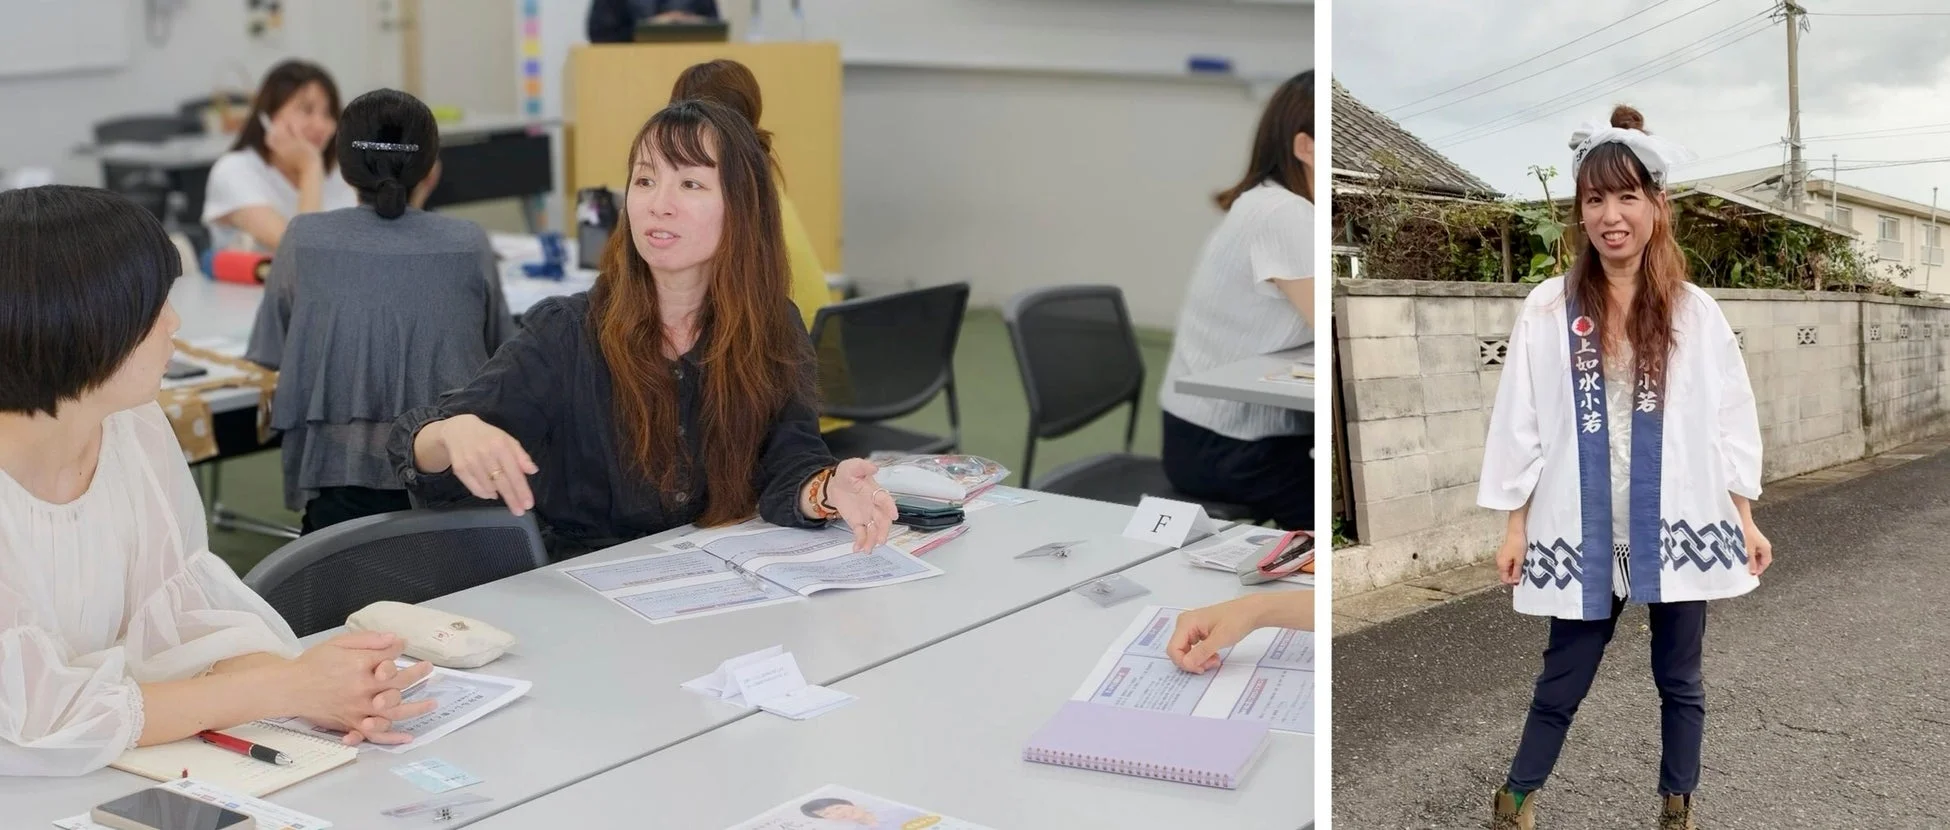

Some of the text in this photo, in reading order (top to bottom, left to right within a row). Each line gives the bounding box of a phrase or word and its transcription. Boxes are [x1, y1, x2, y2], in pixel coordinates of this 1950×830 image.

[1574, 338, 1602, 434] 上如水小若
[1150, 514, 1172, 533] F
